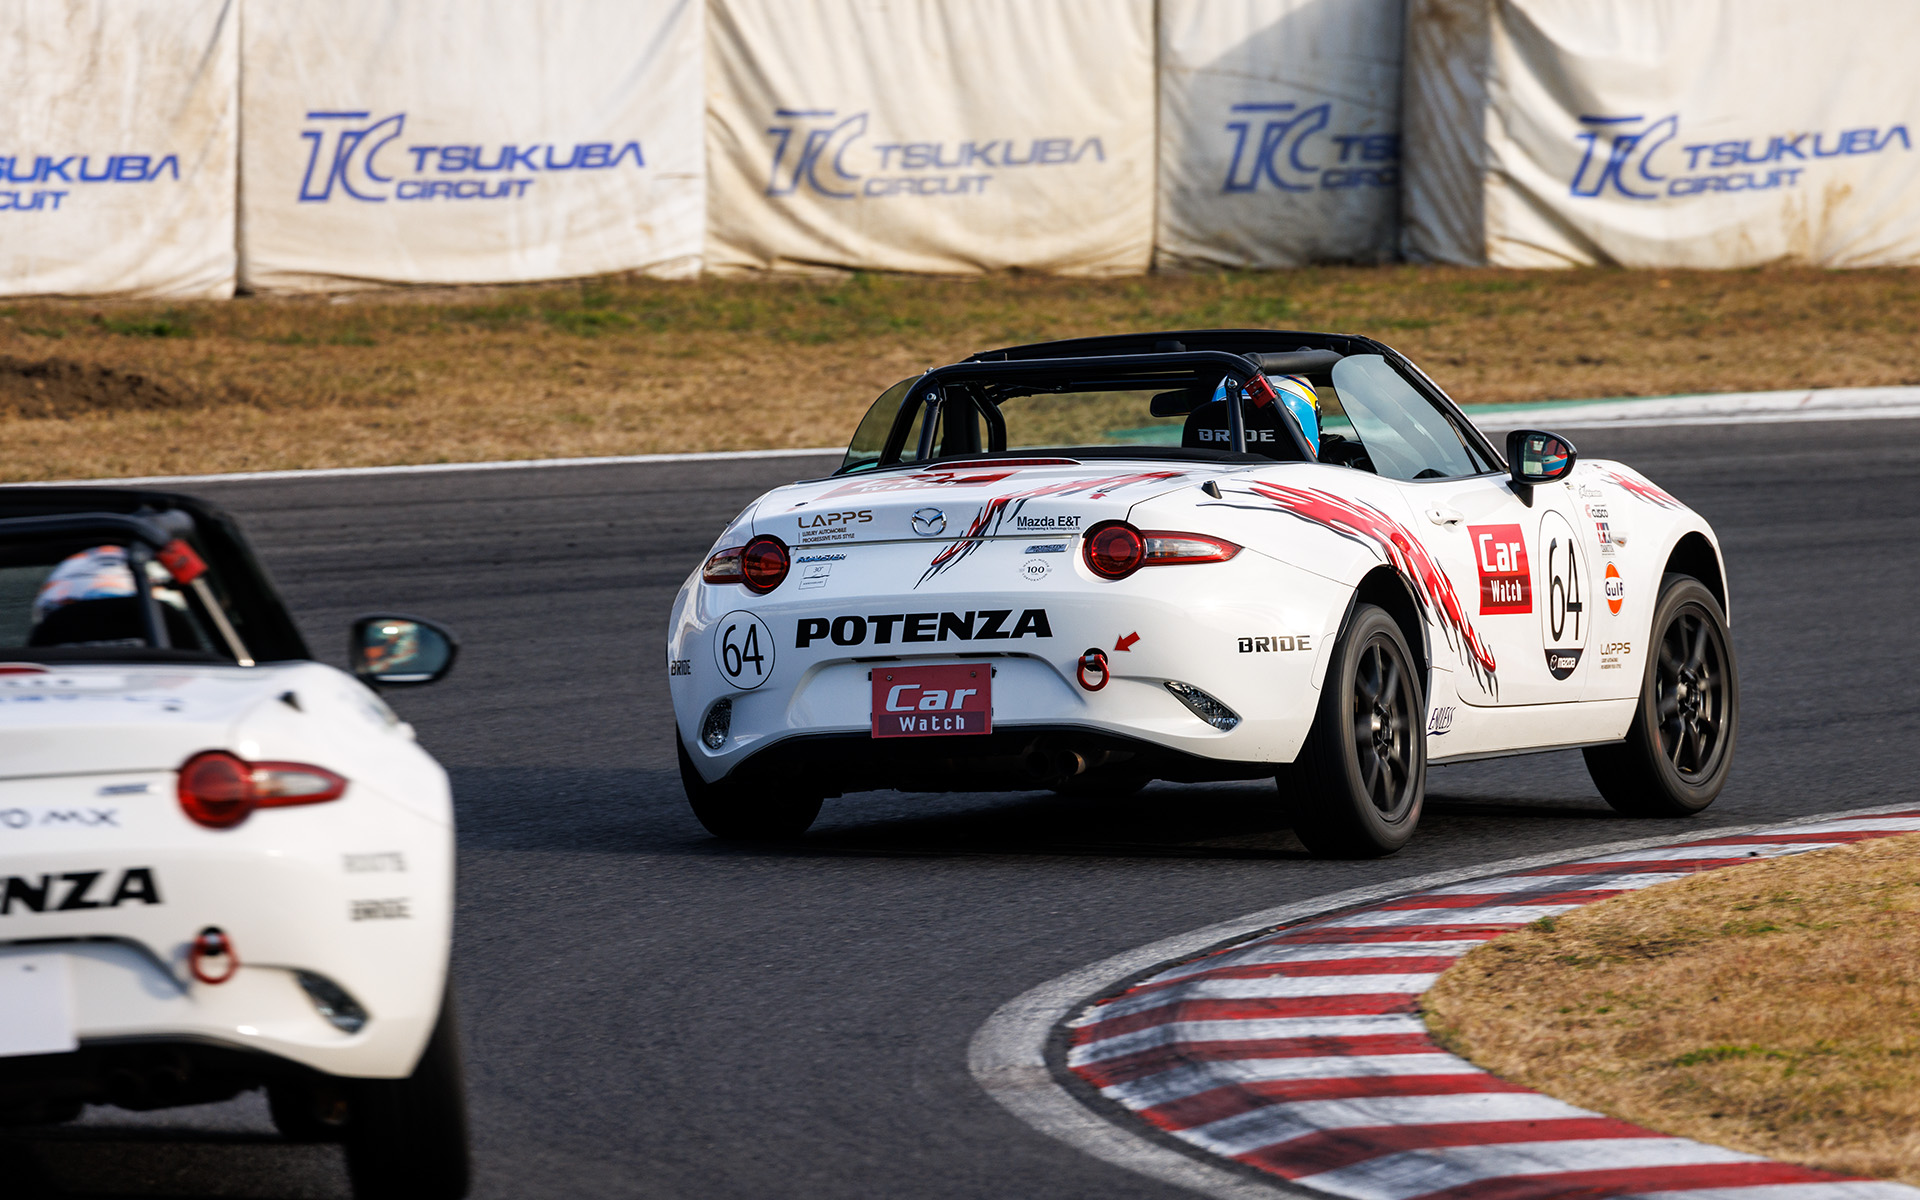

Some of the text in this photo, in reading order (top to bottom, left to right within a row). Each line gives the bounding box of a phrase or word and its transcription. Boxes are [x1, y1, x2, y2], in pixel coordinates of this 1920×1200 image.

[408, 141, 645, 173] TSUKUBA
[872, 136, 1106, 170] TSUKUBA
[1682, 124, 1912, 171] TSUKUBA
[396, 178, 535, 201] CIRCUIT
[863, 175, 994, 198] CIRCUIT
[1667, 167, 1806, 198] CIRCUIT
[1197, 428, 1276, 442] BRDE
[798, 509, 873, 529] LAPPS
[1017, 516, 1081, 527] Mazda E&T
[1478, 533, 1521, 573] Car
[1490, 579, 1522, 602] Watch
[1549, 537, 1583, 642] 64
[1605, 581, 1624, 597] Gulf
[795, 608, 1054, 649] POTENZA
[722, 624, 765, 677] 64
[1237, 635, 1313, 653] BRIDE
[1600, 642, 1631, 655] LAPPS
[671, 660, 692, 676] BRIDE
[885, 684, 978, 712] Car
[899, 714, 965, 732] Watch
[0, 867, 163, 915] NZA
